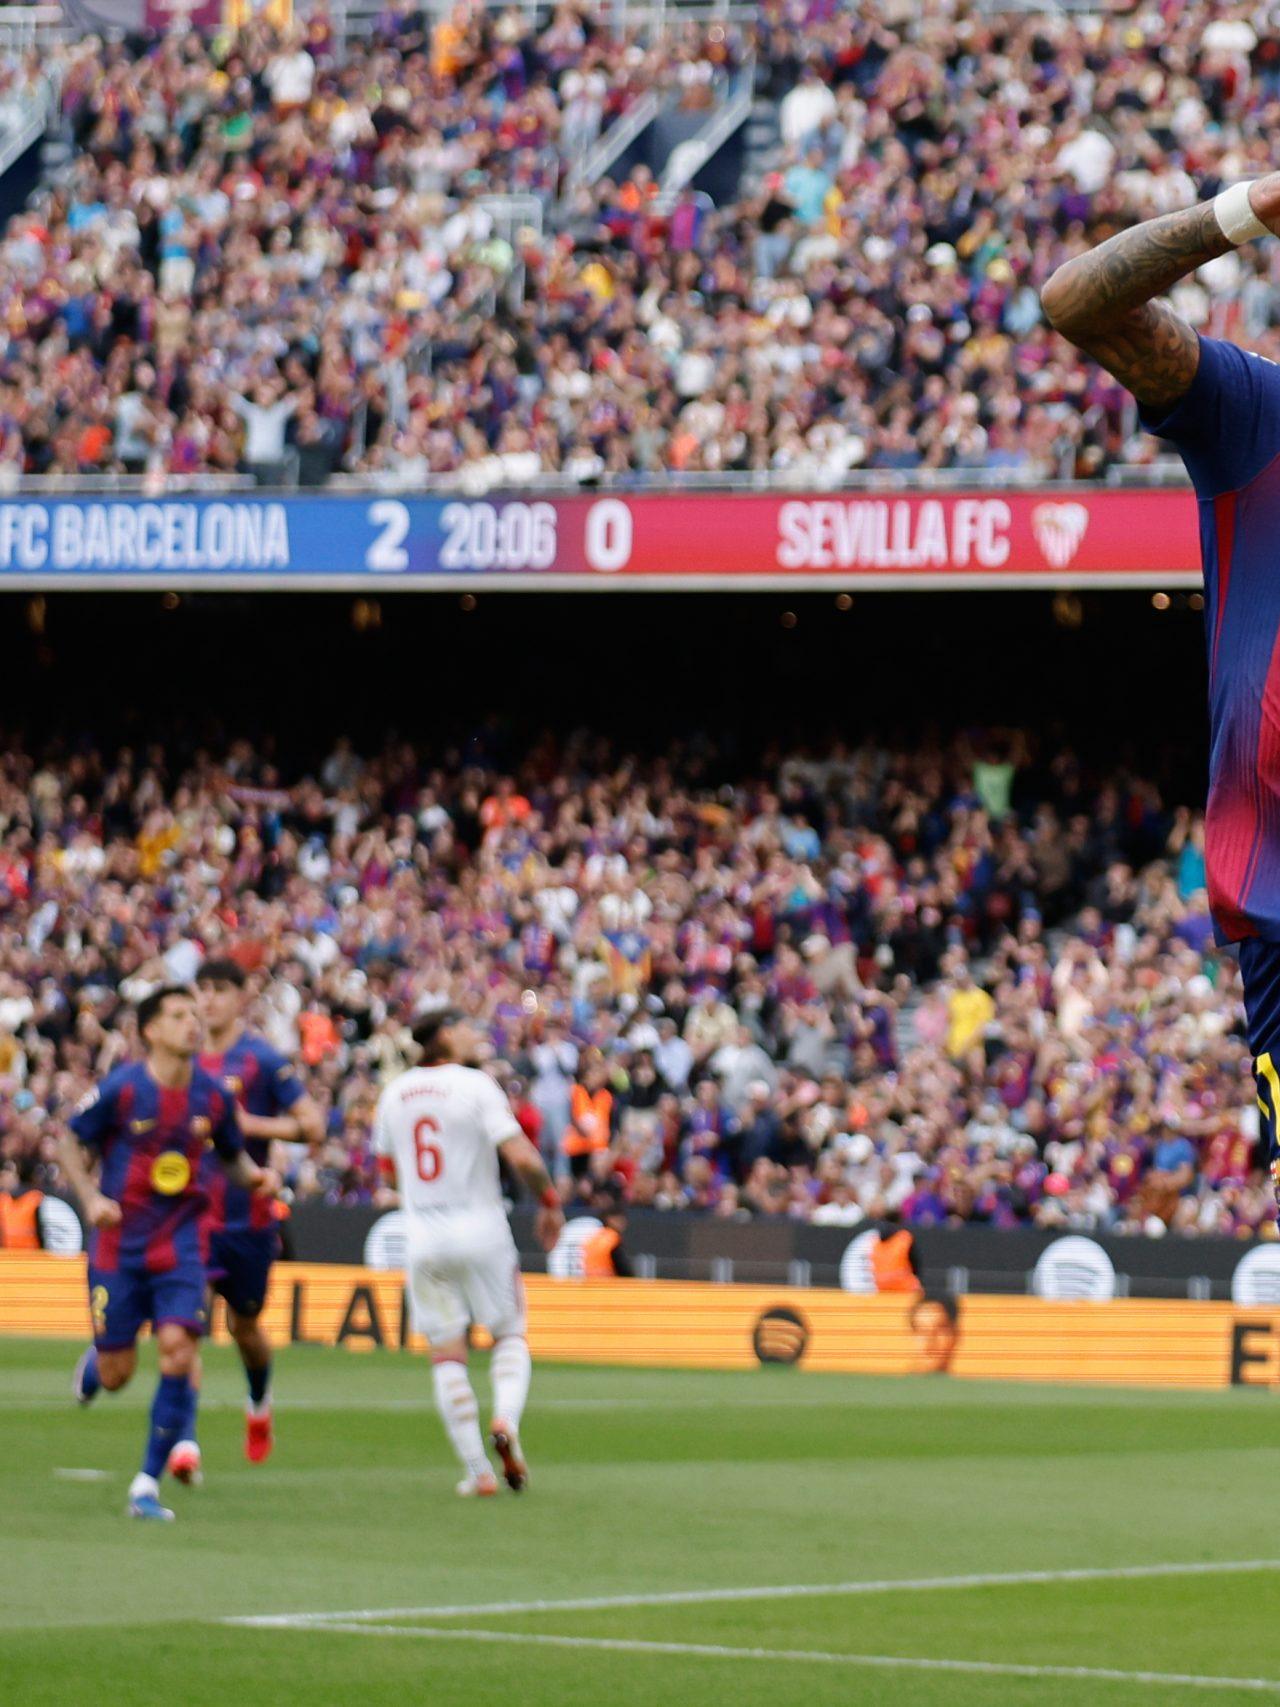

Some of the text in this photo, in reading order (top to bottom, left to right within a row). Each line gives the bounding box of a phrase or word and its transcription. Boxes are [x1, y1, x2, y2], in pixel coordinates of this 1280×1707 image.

[0, 503, 290, 569] FC BARCELONA
[366, 499, 410, 571] 2
[438, 501, 557, 570] 20:06
[585, 498, 633, 571] 0
[777, 499, 1012, 567] SEVILLA FC
[414, 1116, 442, 1182] 6
